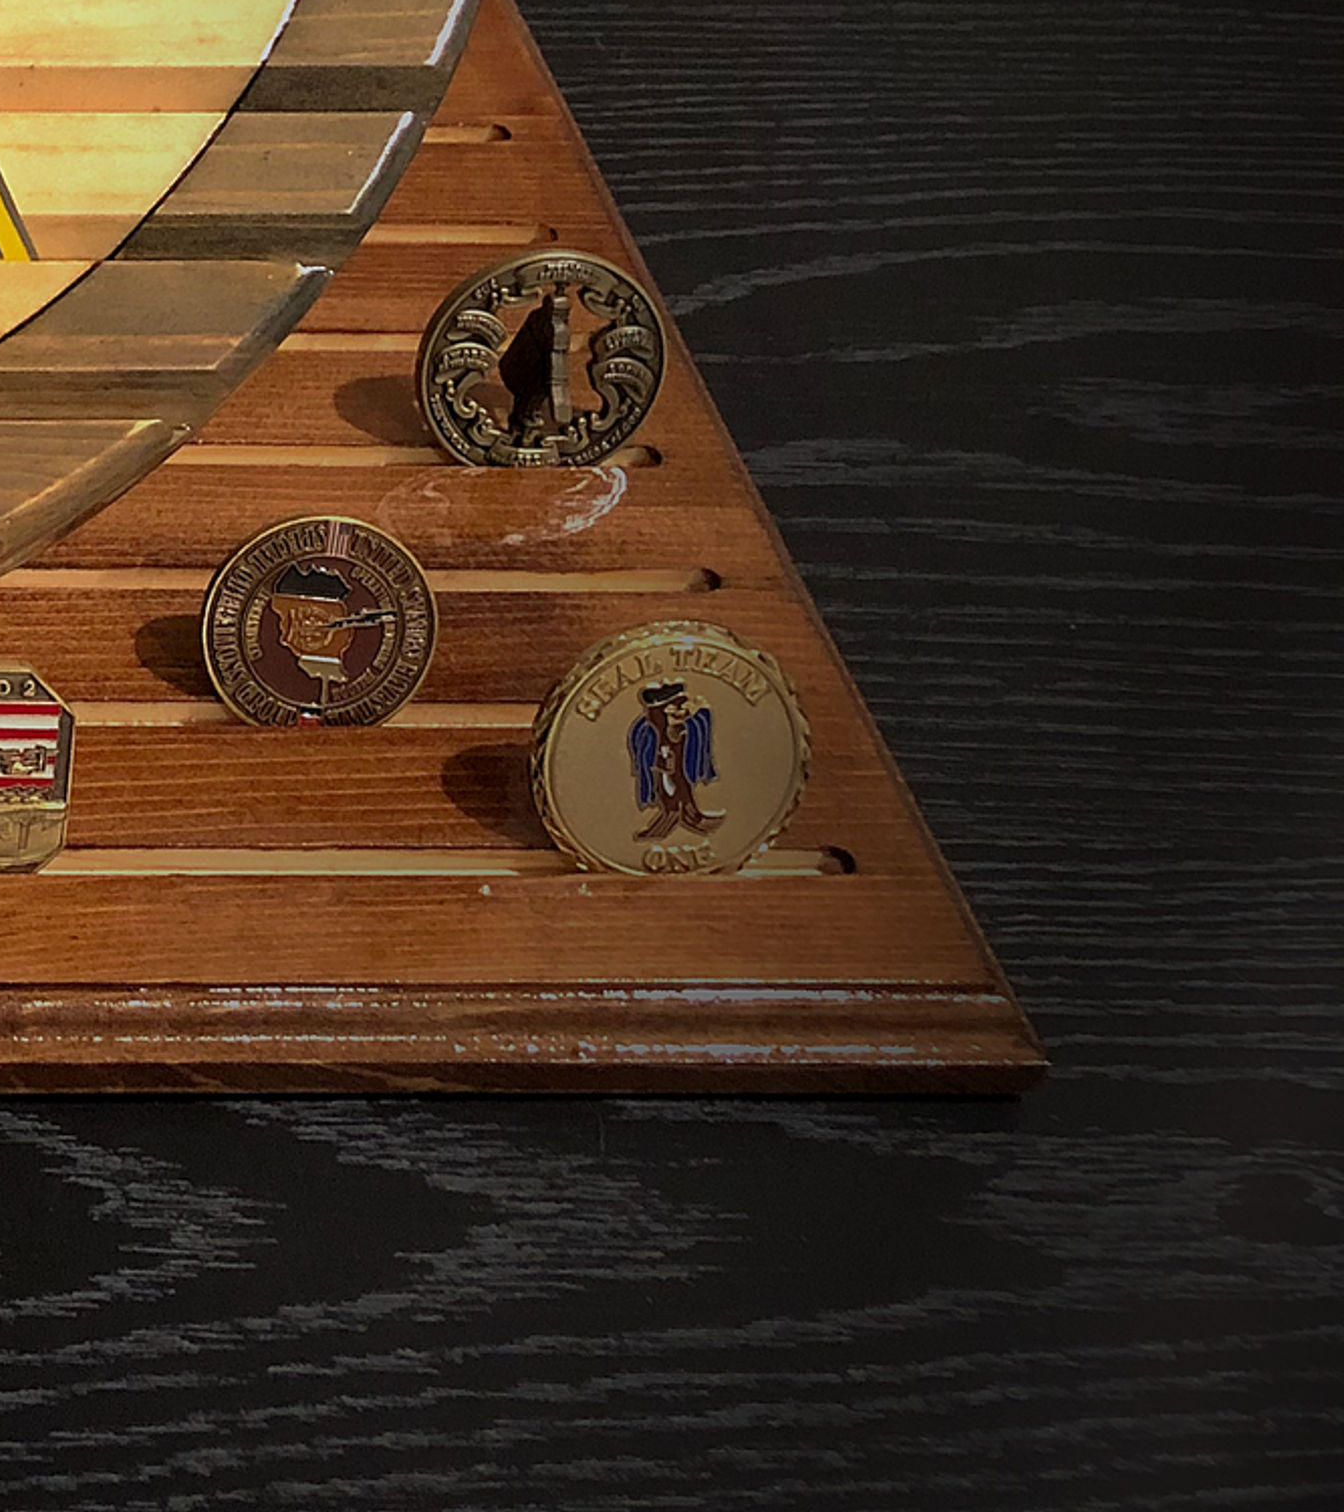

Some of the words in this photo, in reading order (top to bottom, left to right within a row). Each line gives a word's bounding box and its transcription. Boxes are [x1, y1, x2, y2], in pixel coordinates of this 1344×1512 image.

[22, 678, 37, 696] 2
[576, 651, 663, 722] SEAL
[670, 647, 772, 706] TEAM
